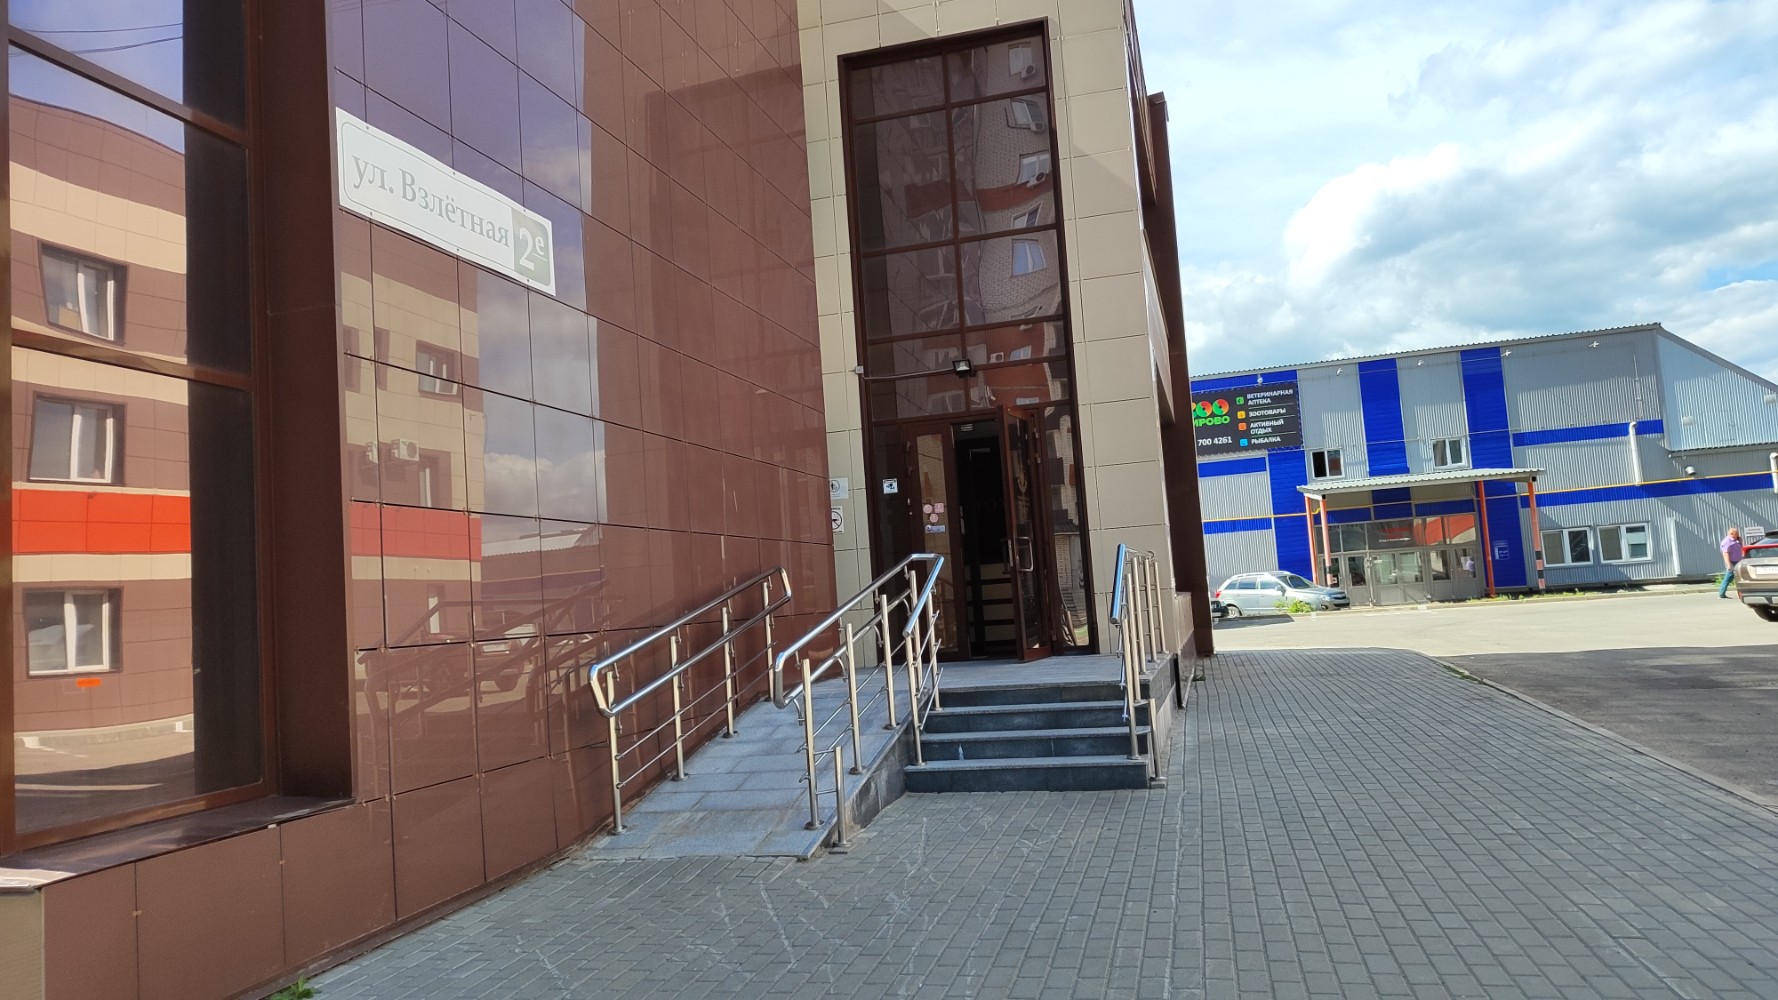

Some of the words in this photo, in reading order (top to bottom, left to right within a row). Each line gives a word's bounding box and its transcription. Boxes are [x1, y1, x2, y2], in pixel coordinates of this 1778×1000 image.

[352, 155, 394, 194] ул.
[399, 168, 510, 248] Взлётная
[1246, 388, 1293, 400] ВЕТЕРИНАРНАЯ
[1248, 398, 1271, 406] АПТЕКА
[1248, 408, 1286, 417] ЗООТОВАРЫ
[1249, 419, 1284, 428] АКТИВНЫЙ
[1250, 427, 1272, 435] ОТДЫХ
[1197, 438, 1212, 447] 700
[1251, 436, 1281, 444] РЫБАЛКА
